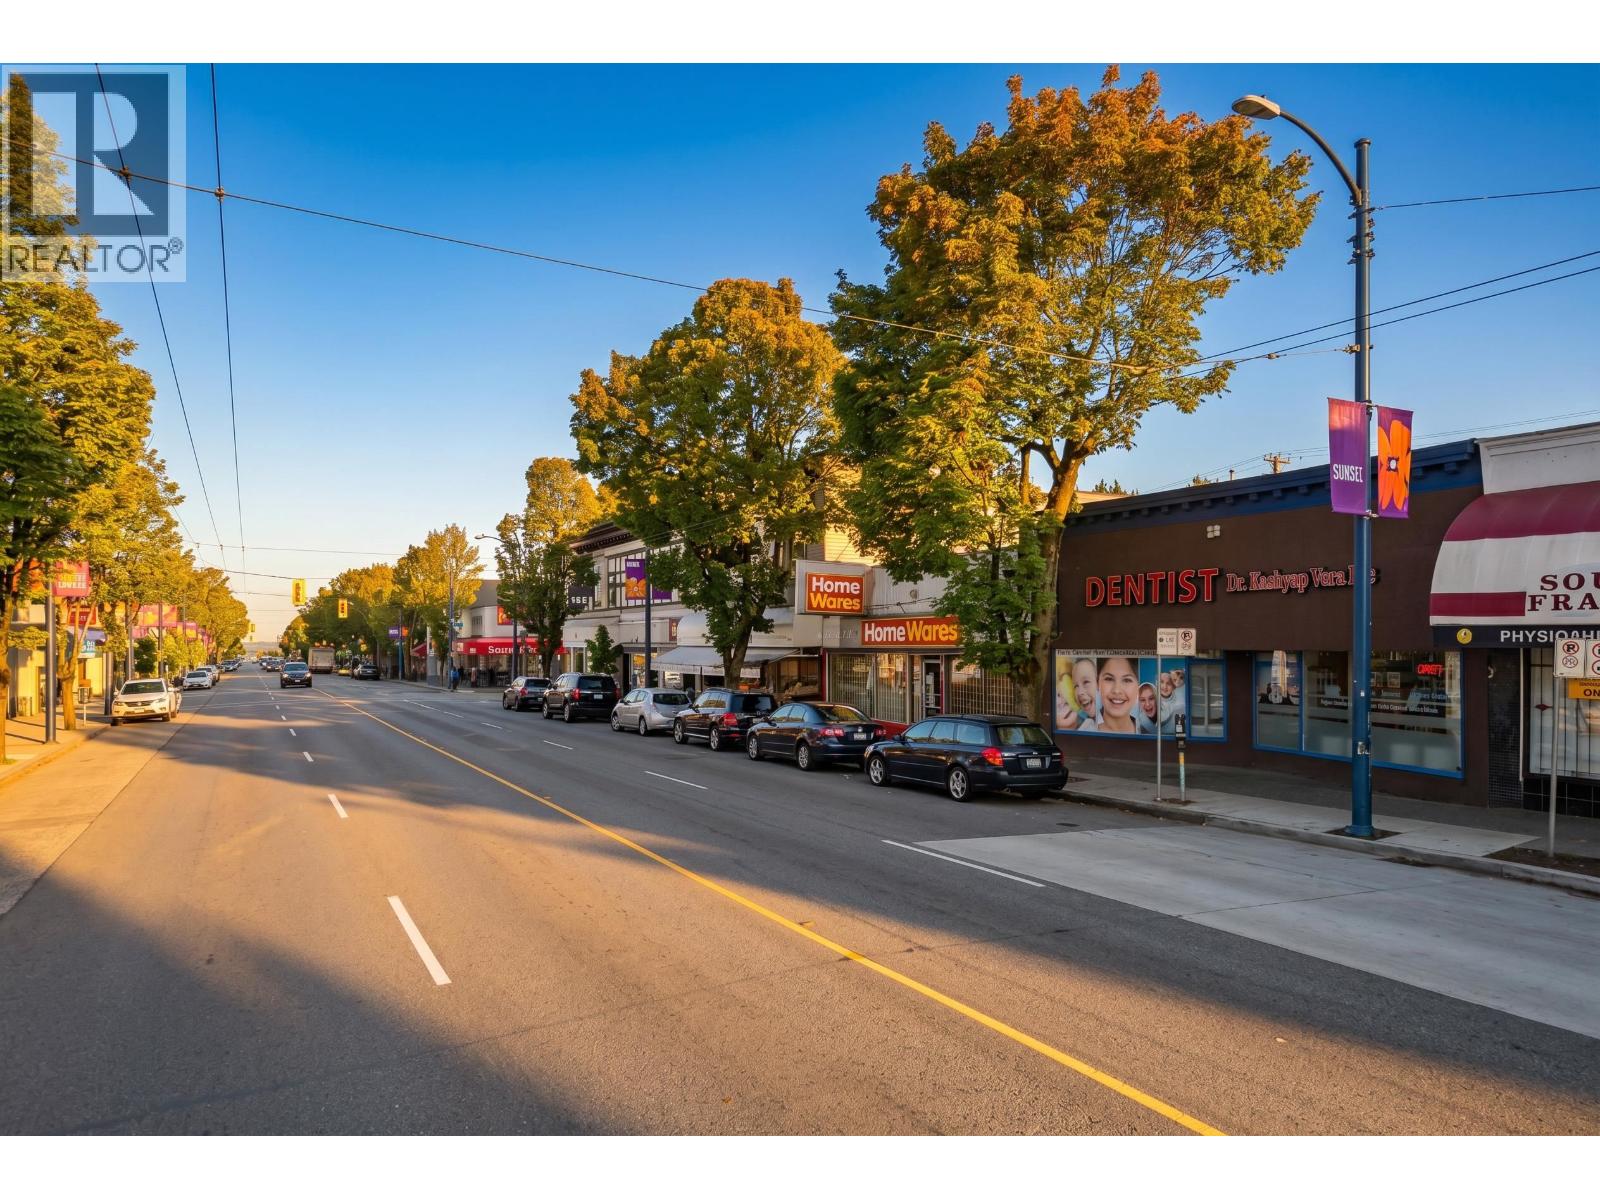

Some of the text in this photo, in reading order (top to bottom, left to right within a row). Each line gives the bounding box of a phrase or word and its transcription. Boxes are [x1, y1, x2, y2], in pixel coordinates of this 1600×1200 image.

[811, 576, 861, 595] Home
[1085, 568, 1219, 607] DENTIST
[1226, 573, 1248, 592] Dr.
[1249, 570, 1309, 594] Kashyap
[809, 592, 861, 610] Wares
[864, 622, 906, 642] Home
[906, 620, 959, 642] Wares
